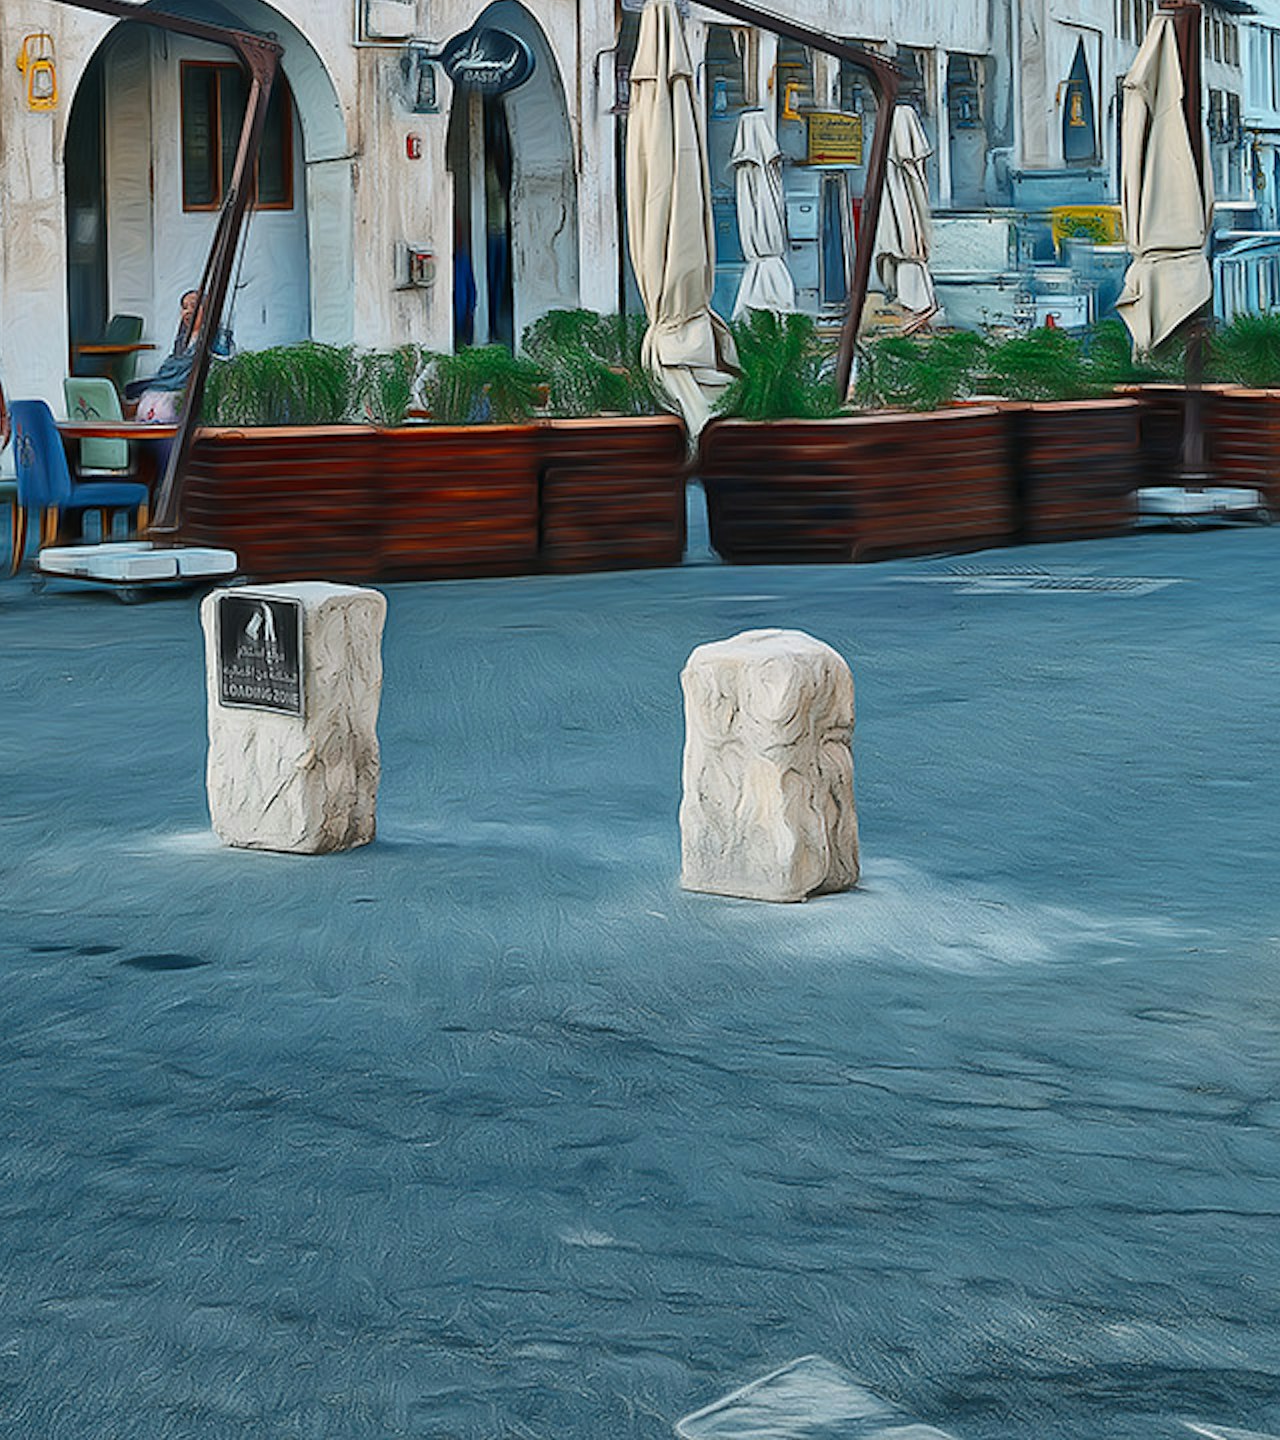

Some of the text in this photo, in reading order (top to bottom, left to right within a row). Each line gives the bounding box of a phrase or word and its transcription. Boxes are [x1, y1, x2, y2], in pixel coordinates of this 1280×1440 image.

[464, 69, 502, 84] BASTA
[223, 682, 299, 706] LOADING ZONE
